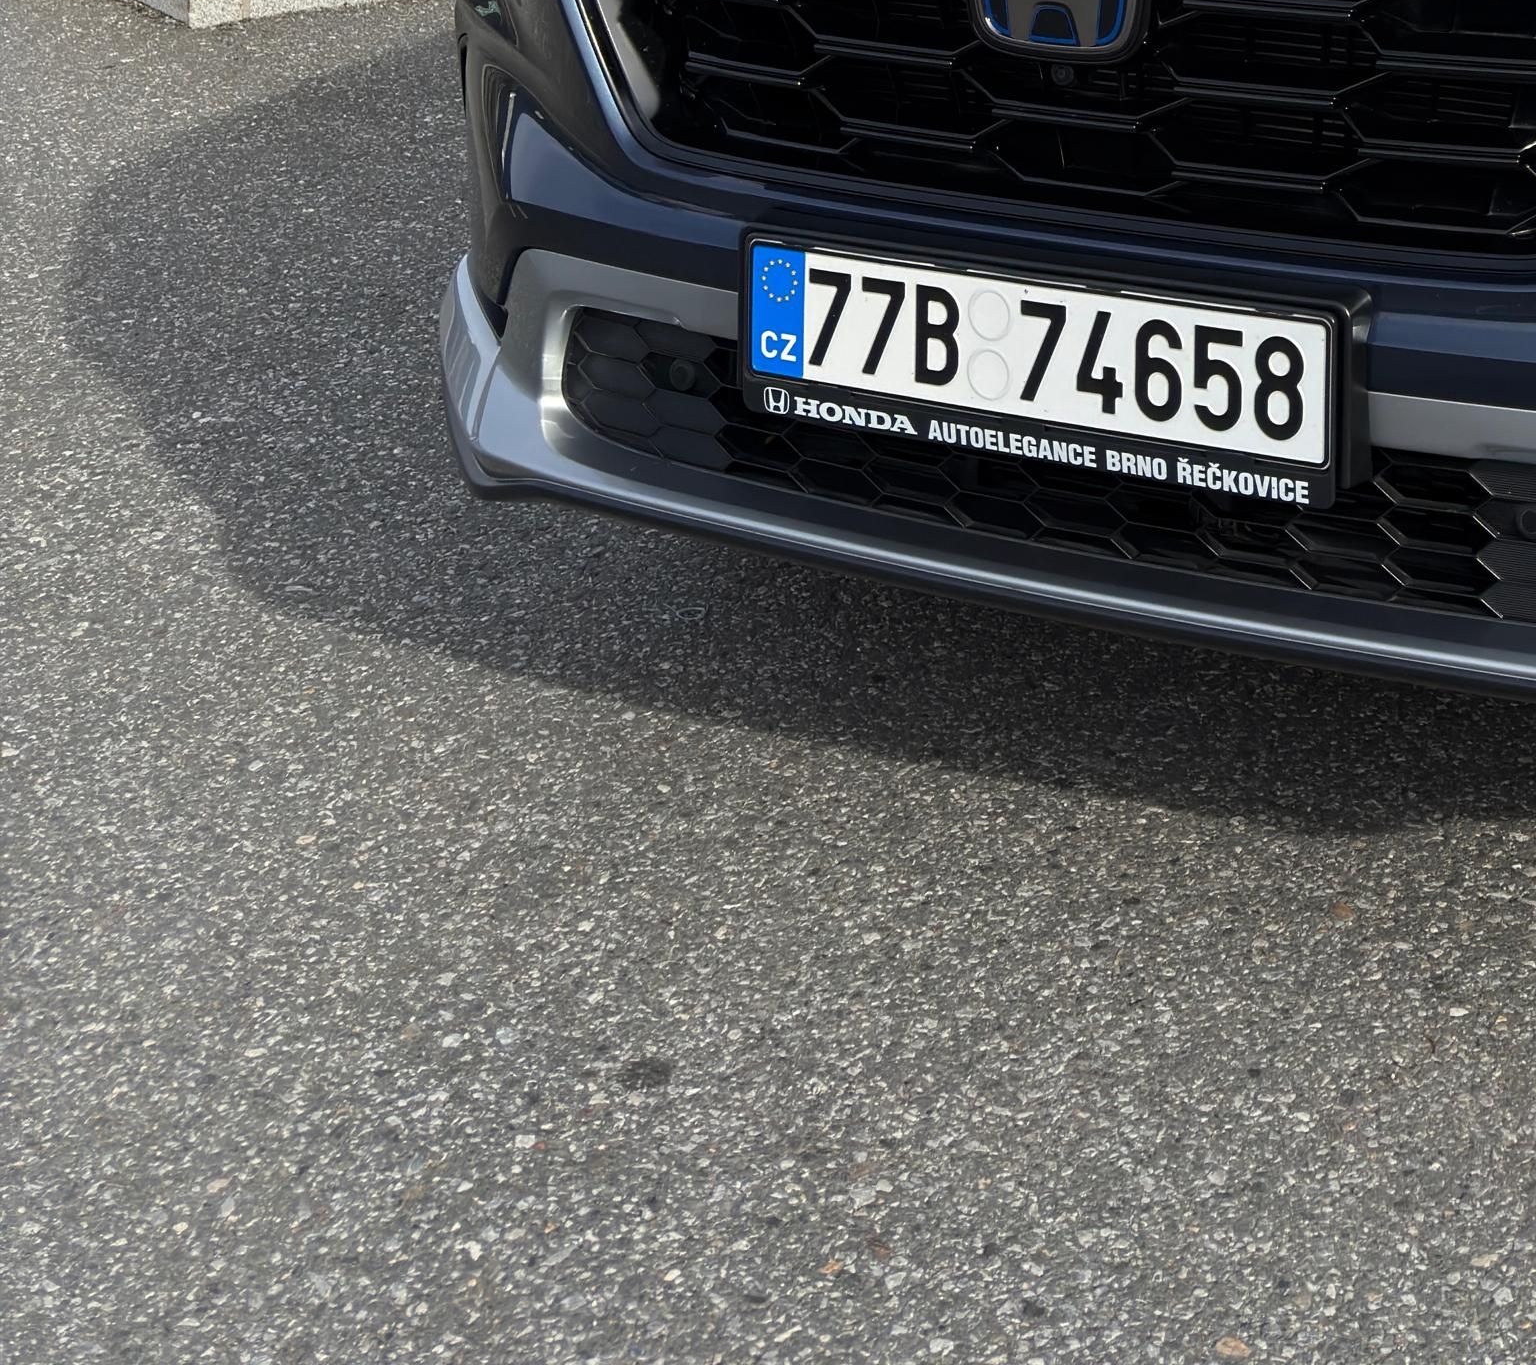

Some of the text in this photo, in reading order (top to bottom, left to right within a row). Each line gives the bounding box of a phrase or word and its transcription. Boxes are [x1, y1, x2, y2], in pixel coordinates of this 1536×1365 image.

[760, 267, 1305, 441] CZ 77B 74658
[793, 395, 918, 436] HONDA
[927, 419, 1097, 469] AUTOELEGANCE
[1105, 449, 1168, 481] BRNO
[1176, 457, 1311, 505] ŘEČKOVICE
